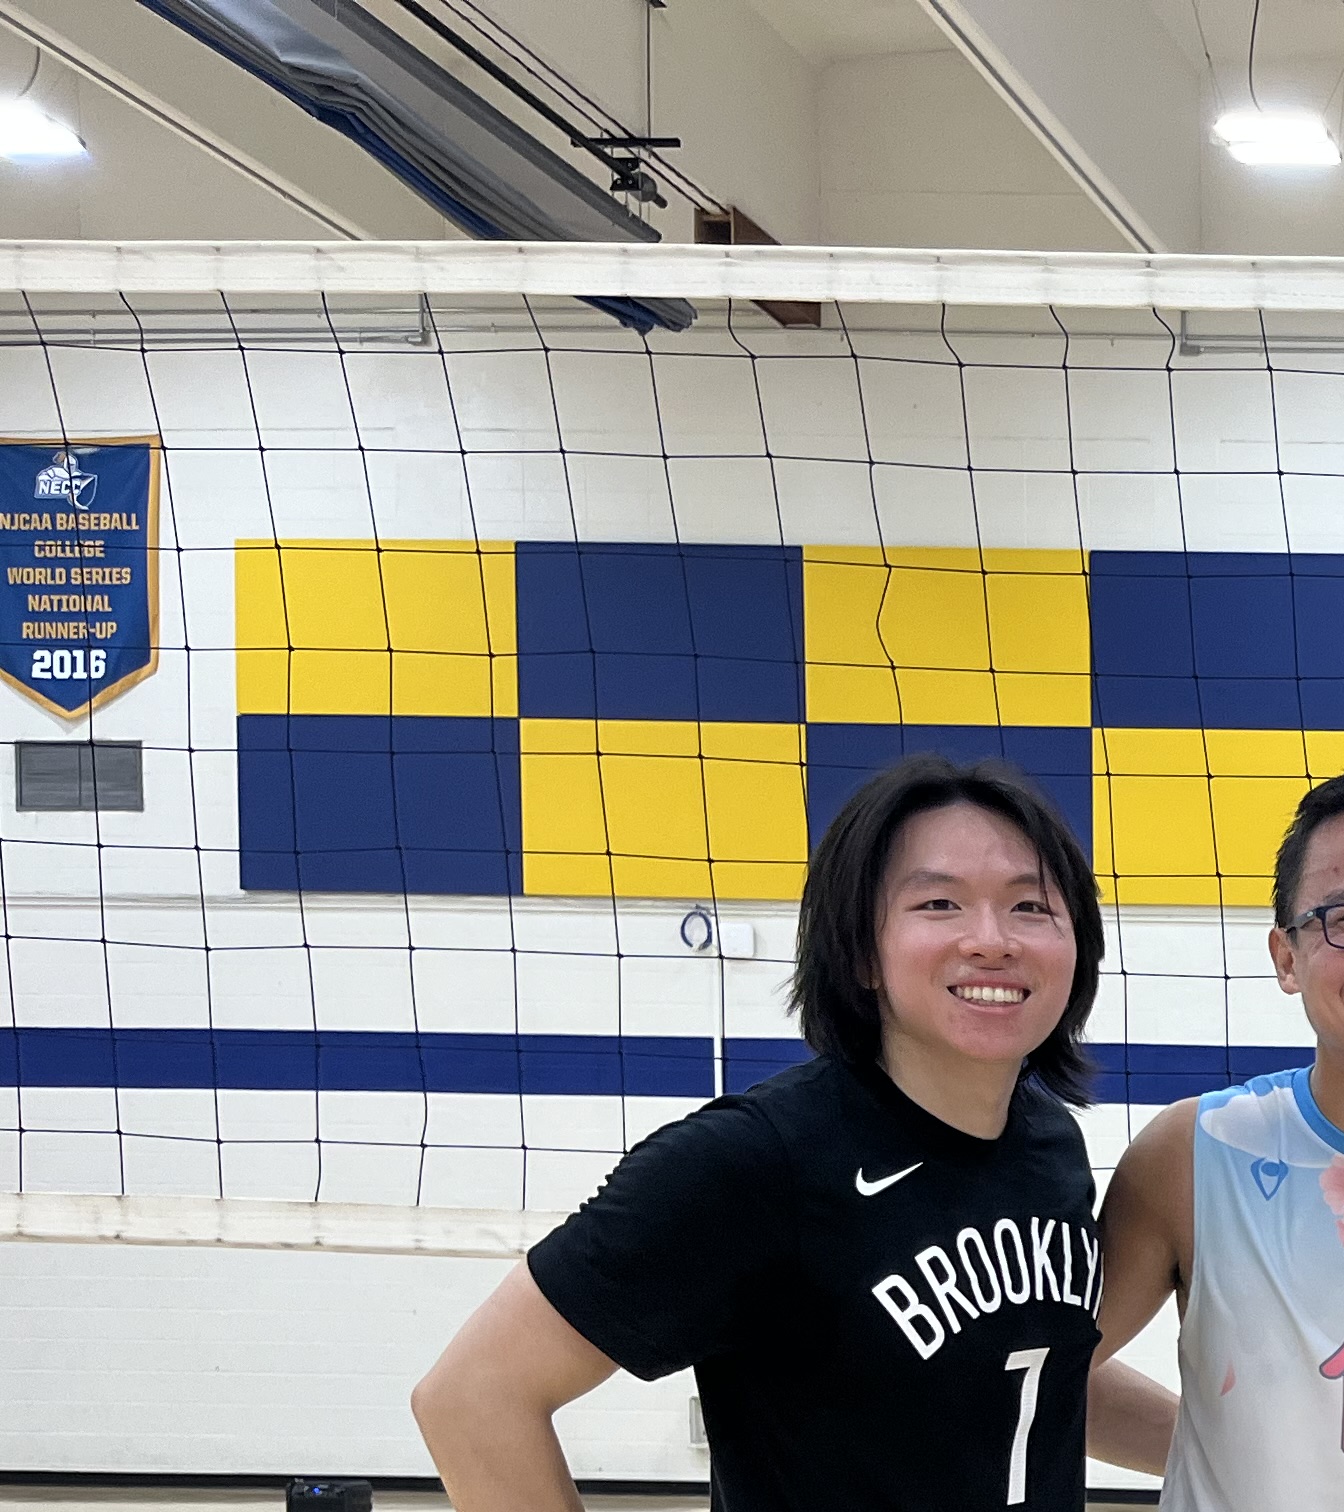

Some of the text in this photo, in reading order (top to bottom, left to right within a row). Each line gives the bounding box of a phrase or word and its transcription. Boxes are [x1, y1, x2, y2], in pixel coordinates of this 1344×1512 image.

[38, 480, 81, 495] NECC
[0, 513, 139, 530] NJCAA BASEBALL
[7, 567, 131, 585] WORLD SERIES
[27, 594, 112, 612] NATIONAL
[22, 622, 117, 640] RUNNER-UP
[31, 649, 107, 680] 2016
[872, 1216, 1104, 1360] BROOKLY
[1004, 1347, 1050, 1506] 7
